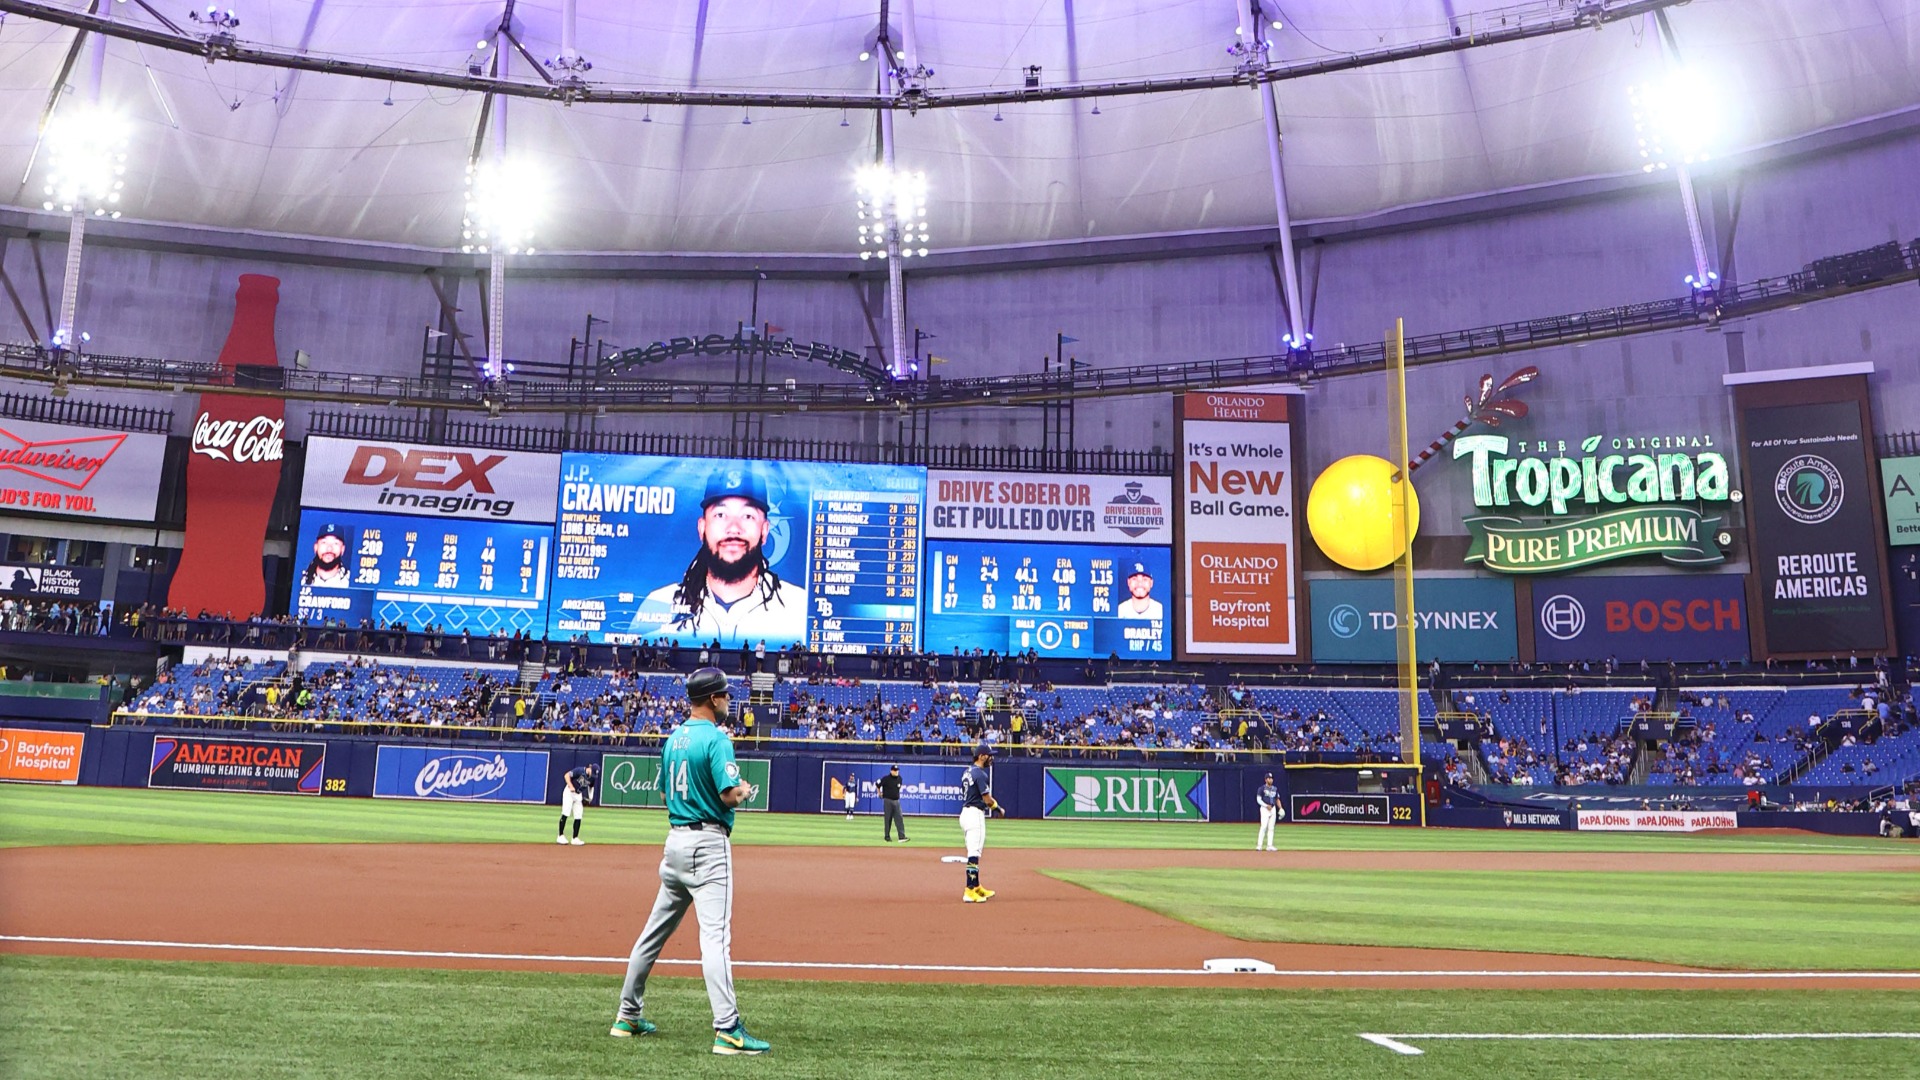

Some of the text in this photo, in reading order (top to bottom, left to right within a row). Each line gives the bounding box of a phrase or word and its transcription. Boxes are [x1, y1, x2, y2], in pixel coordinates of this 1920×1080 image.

[1207, 395, 1265, 407] ORLANDO
[1213, 407, 1260, 419] HEALTH
[192, 411, 284, 462] Coca-Cola
[1612, 434, 1714, 450] ORIGINAL
[1783, 438, 1798, 446] Your
[1188, 442, 1284, 458] It's a Whole
[342, 445, 508, 494] DEX
[564, 464, 594, 482] J.P.
[1453, 434, 1730, 515] Tropicana
[1189, 461, 1285, 496] New
[562, 483, 676, 515] CRAWFORD
[938, 480, 1091, 506] DRIVE SOBER OR
[33, 491, 61, 509] FOR
[65, 494, 96, 512] YOU.
[378, 487, 515, 516] imaging
[1190, 500, 1290, 517] Ball Game.
[933, 505, 1095, 532] GET PULLED OVER
[1105, 506, 1162, 516] DRIVE SOBER OR
[1104, 515, 1164, 526] GET PULLED OVER
[363, 529, 381, 540] AVG
[406, 531, 418, 542] HR
[443, 534, 458, 545] RBI
[561, 521, 584, 535] LONG
[617, 524, 629, 537] CA
[1486, 516, 1700, 563] PURE PREMIUM
[407, 543, 415, 558] 7
[480, 547, 496, 563] 44
[1023, 557, 1031, 567] IP
[1056, 558, 1072, 569] ERA
[1091, 559, 1112, 569] WHIP
[1200, 554, 1279, 570] ORLANDO
[1777, 552, 1858, 576] REROUTE
[43, 568, 72, 578] BLACK
[557, 565, 600, 579] 9/5/2017
[1209, 570, 1272, 585] HEALTH
[42, 576, 81, 587] HISTORY
[1774, 575, 1868, 599] AMERICAS
[41, 585, 80, 595] MATTERS
[1210, 599, 1271, 614] Bayfront
[1212, 614, 1269, 630] Hospital
[1368, 611, 1398, 630] TD
[1605, 598, 1742, 633] BOSCH
[18, 741, 75, 757] Bayfront
[175, 743, 303, 768] AMERICAN
[15, 756, 70, 771] Hospital
[173, 763, 299, 779] PLUMBING HEATING & COOLING
[414, 754, 508, 796] Culver's
[669, 760, 688, 801] 14
[325, 779, 346, 792] 382
[1104, 775, 1186, 814] RIPA
[1322, 802, 1380, 816] OptiBrand Rx
[1392, 806, 1411, 820] 322
[1513, 813, 1561, 825] MLB NETWORK
[1580, 815, 1600, 826] PAPA
[1637, 816, 1656, 827] PAPA
[1691, 817, 1711, 828] PAPA
